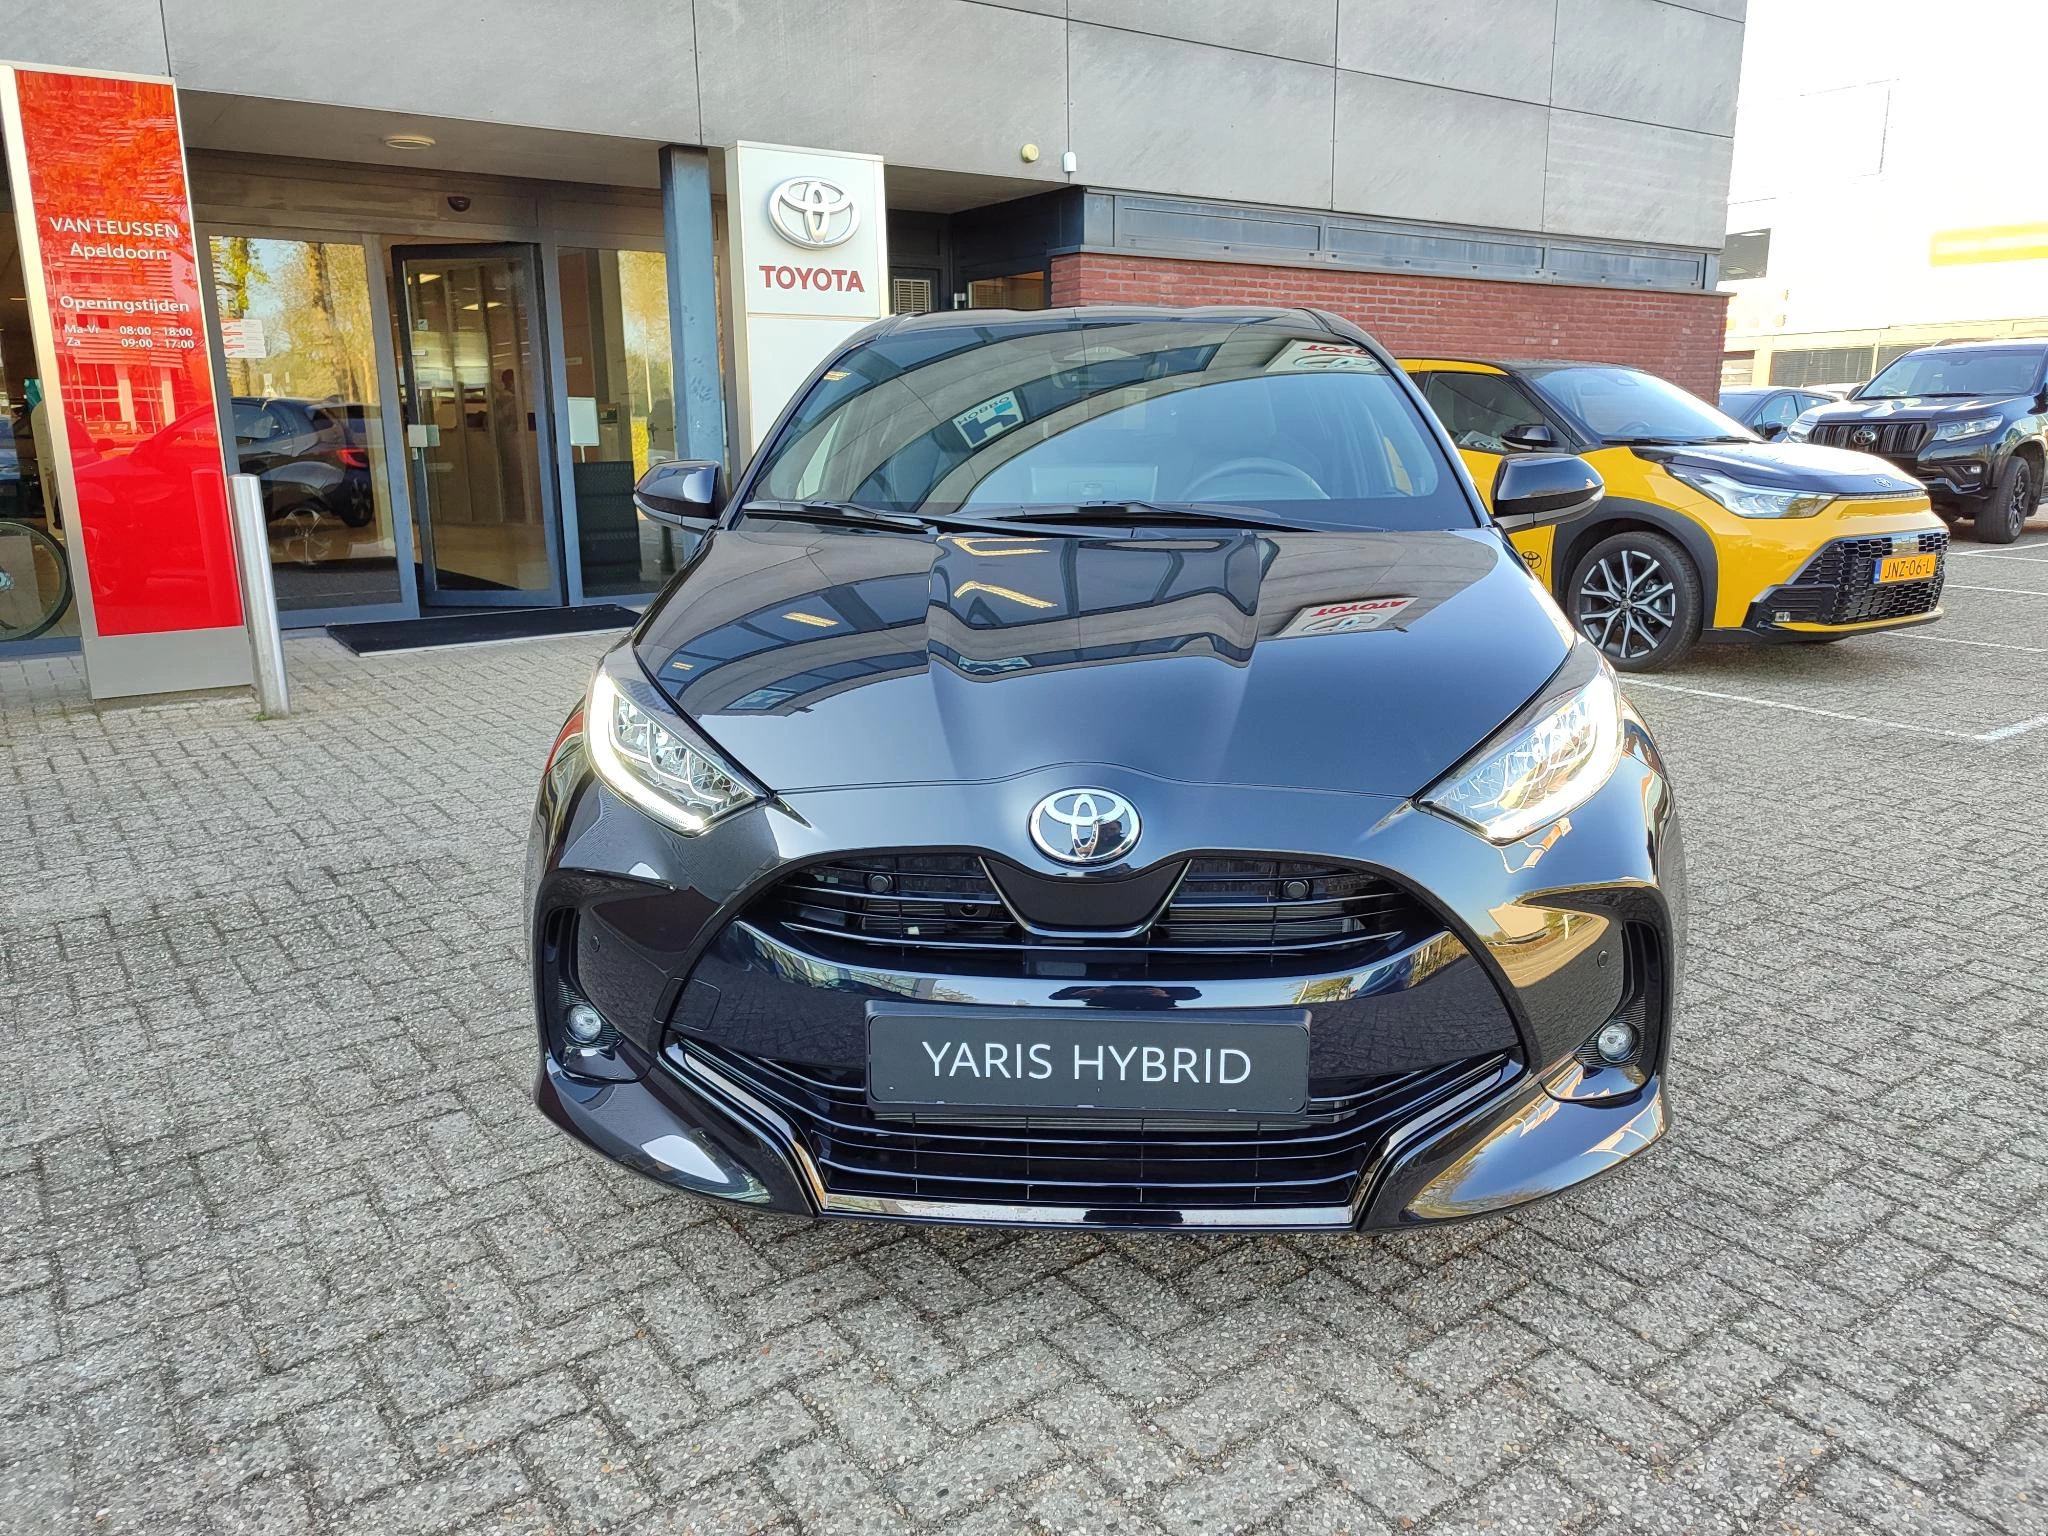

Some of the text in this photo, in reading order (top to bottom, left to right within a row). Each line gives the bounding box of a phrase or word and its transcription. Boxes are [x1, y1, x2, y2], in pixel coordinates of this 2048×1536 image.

[49, 216, 180, 239] VAN LEUSSEN
[70, 241, 168, 261] Apeldoorn
[758, 265, 866, 293] TOYOTA
[59, 295, 190, 316] Openingstijden
[64, 324, 101, 334] Ma-Vr
[119, 325, 152, 336] 08:00
[162, 326, 193, 337] 18:00
[66, 336, 81, 347] Za
[121, 338, 153, 348] 09:00
[164, 339, 195, 349] 17:00
[1884, 558, 1931, 579] JNZ-06-L
[921, 1040, 1252, 1085] YARIS HYBRID
